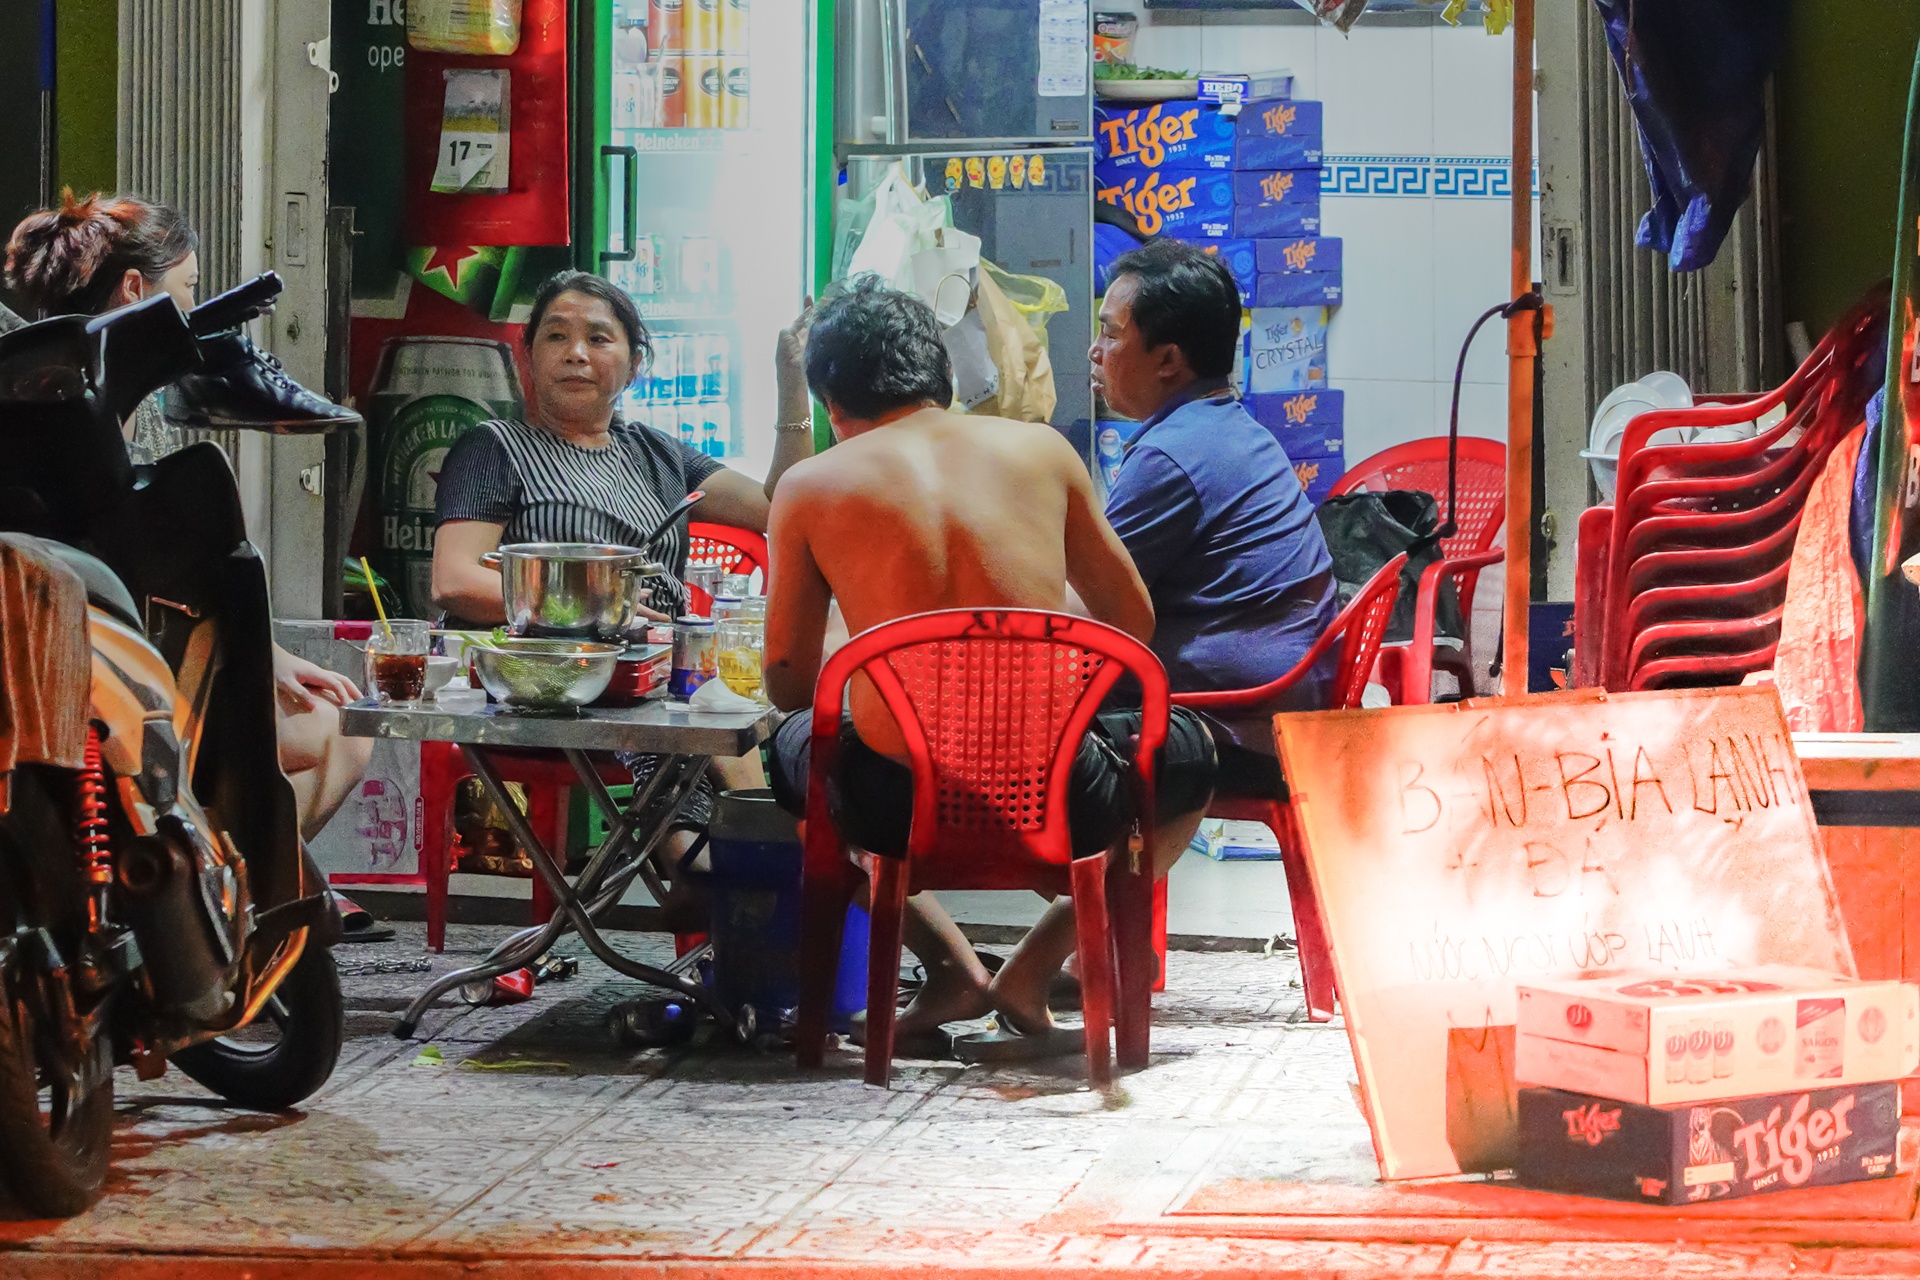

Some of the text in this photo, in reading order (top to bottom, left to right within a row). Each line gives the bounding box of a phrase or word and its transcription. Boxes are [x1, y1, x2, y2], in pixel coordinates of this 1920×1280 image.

[1262, 104, 1296, 134] Tiger
[634, 133, 700, 150] Heineken
[1100, 104, 1199, 168] Tiger
[1115, 143, 1187, 167] SINCE 1932
[1260, 172, 1294, 201] Tiger
[1097, 172, 1196, 236] Tiger
[1166, 212, 1185, 222] 1932
[1283, 240, 1316, 269] Tiger
[640, 301, 696, 318] eineken
[1265, 323, 1288, 343] Tiger
[1256, 334, 1323, 369] CRYSTAL
[1283, 394, 1317, 423] Tiger
[1563, 1104, 1622, 1146] Tiger
[1733, 1094, 1855, 1185] Tiger
[1753, 1146, 1841, 1191] SINCE 1932
